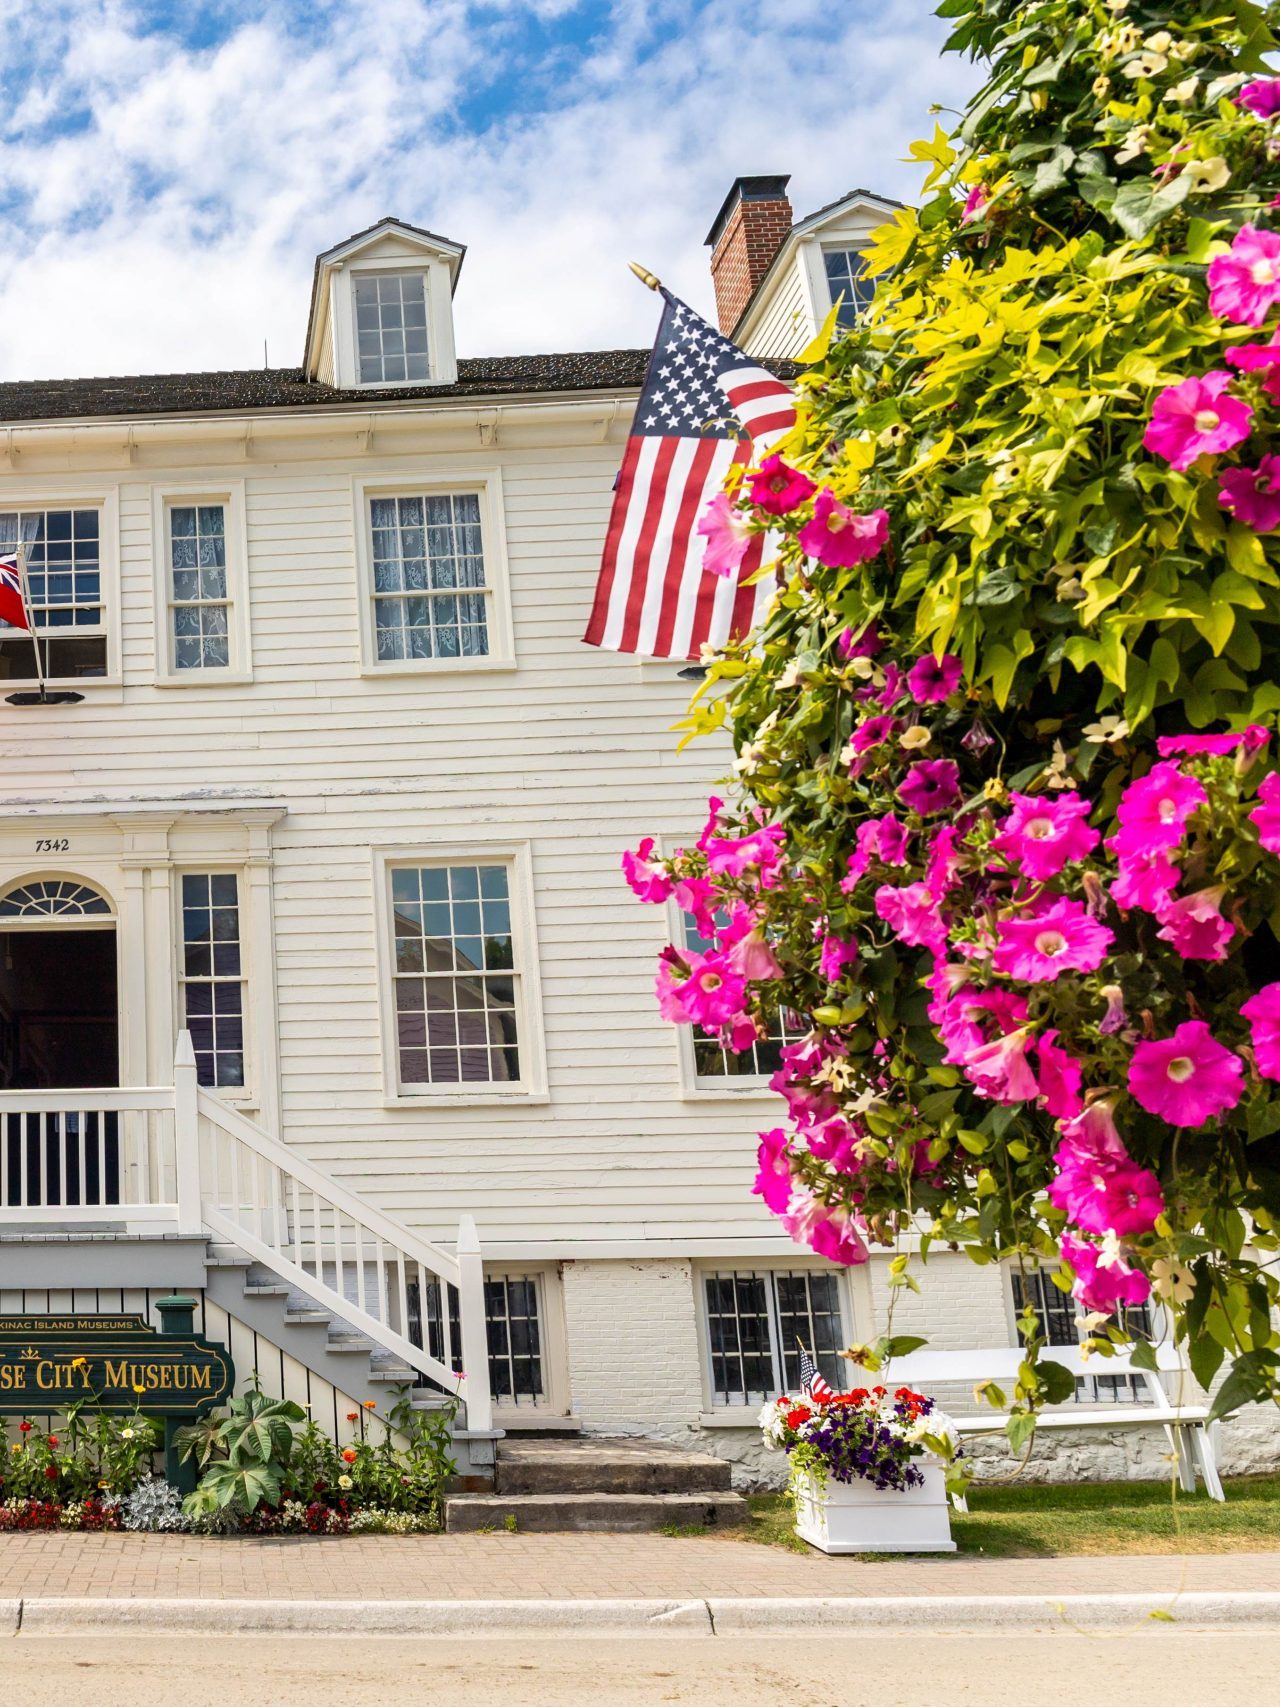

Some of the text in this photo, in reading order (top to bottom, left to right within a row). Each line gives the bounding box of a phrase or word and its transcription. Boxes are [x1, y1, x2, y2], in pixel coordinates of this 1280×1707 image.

[35, 838, 70, 853] 7342
[34, 1321, 74, 1330] ISLAND
[77, 1320, 133, 1330] MUSEUMS
[36, 1360, 94, 1389] CITY
[104, 1360, 212, 1389] MUSEUM
